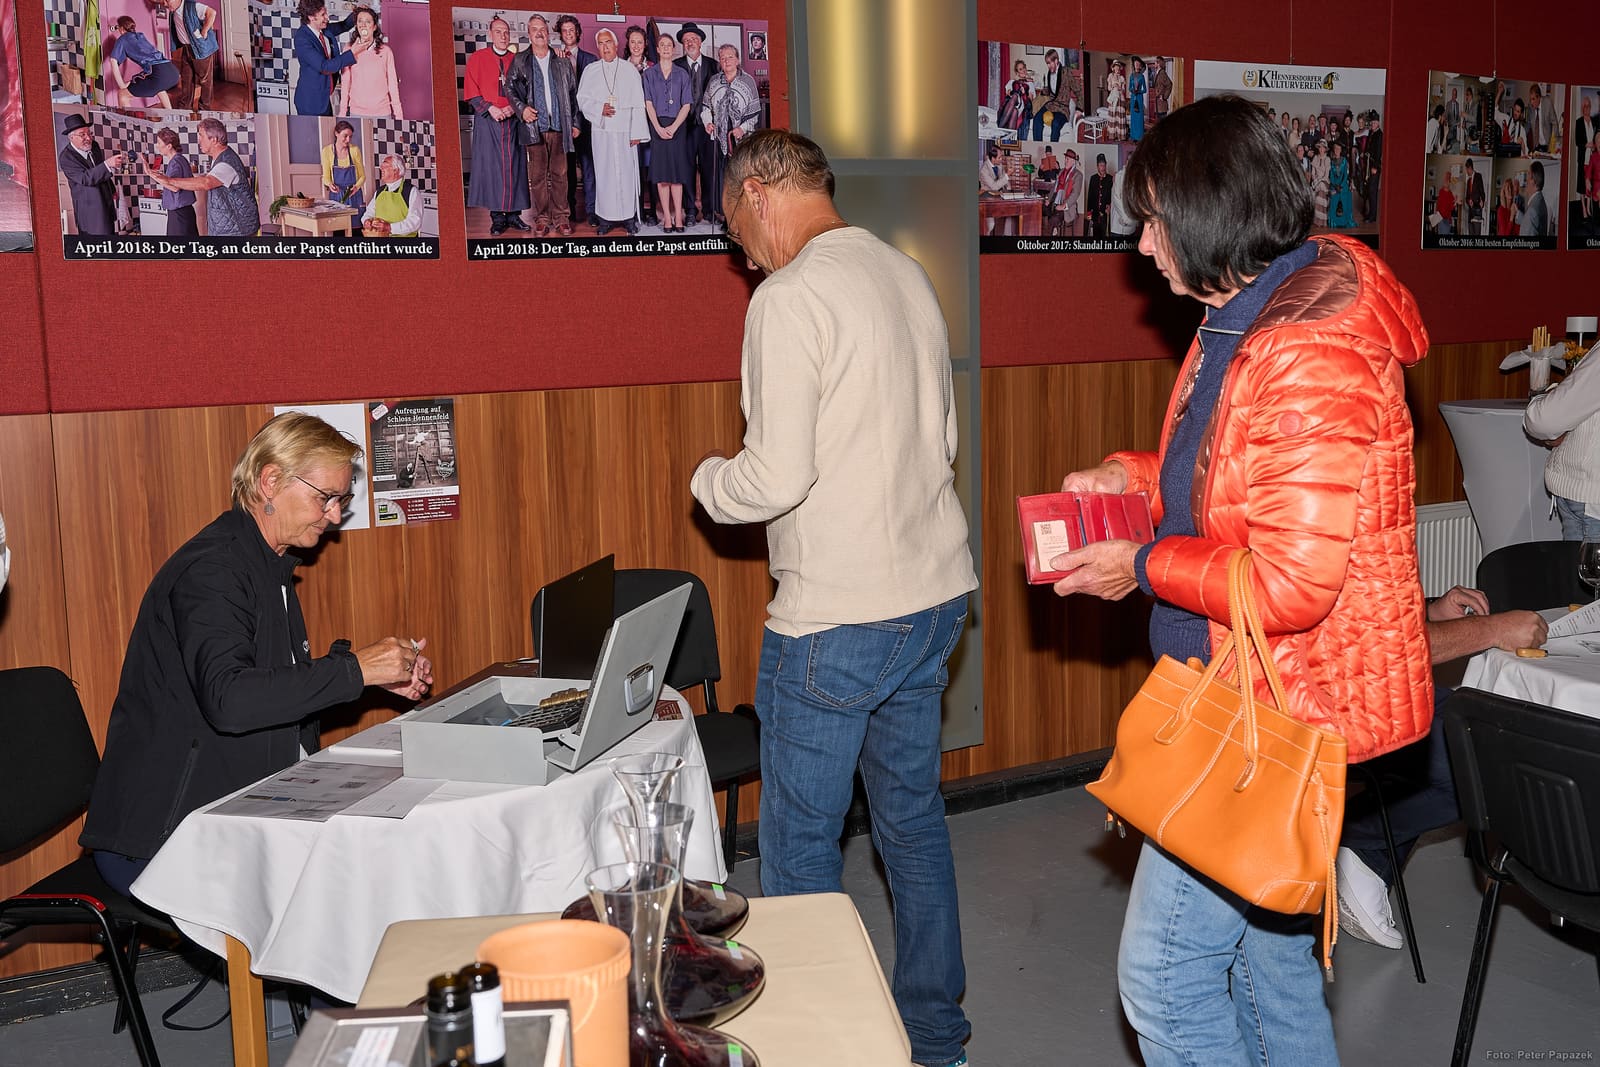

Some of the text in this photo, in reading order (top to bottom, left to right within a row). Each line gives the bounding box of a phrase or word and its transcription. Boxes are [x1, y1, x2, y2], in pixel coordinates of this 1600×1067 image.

[1258, 69, 1322, 90] KULTURVEREIN
[74, 240, 433, 258] April 2018: Der Tag, an dem der Papst entführt wurde
[473, 239, 733, 259] April 2018: Der Tag, an dem der Papst entführ
[1017, 239, 1049, 250] Oktober
[1050, 240, 1071, 250] 2017:
[1073, 239, 1103, 250] Skandal
[1104, 240, 1112, 250] in
[1438, 237, 1540, 249] Oktober 2016: Mit besten Empfehlungen
[394, 406, 429, 415] Aufregung
[430, 405, 441, 413] auf
[387, 415, 412, 423] Schloss
